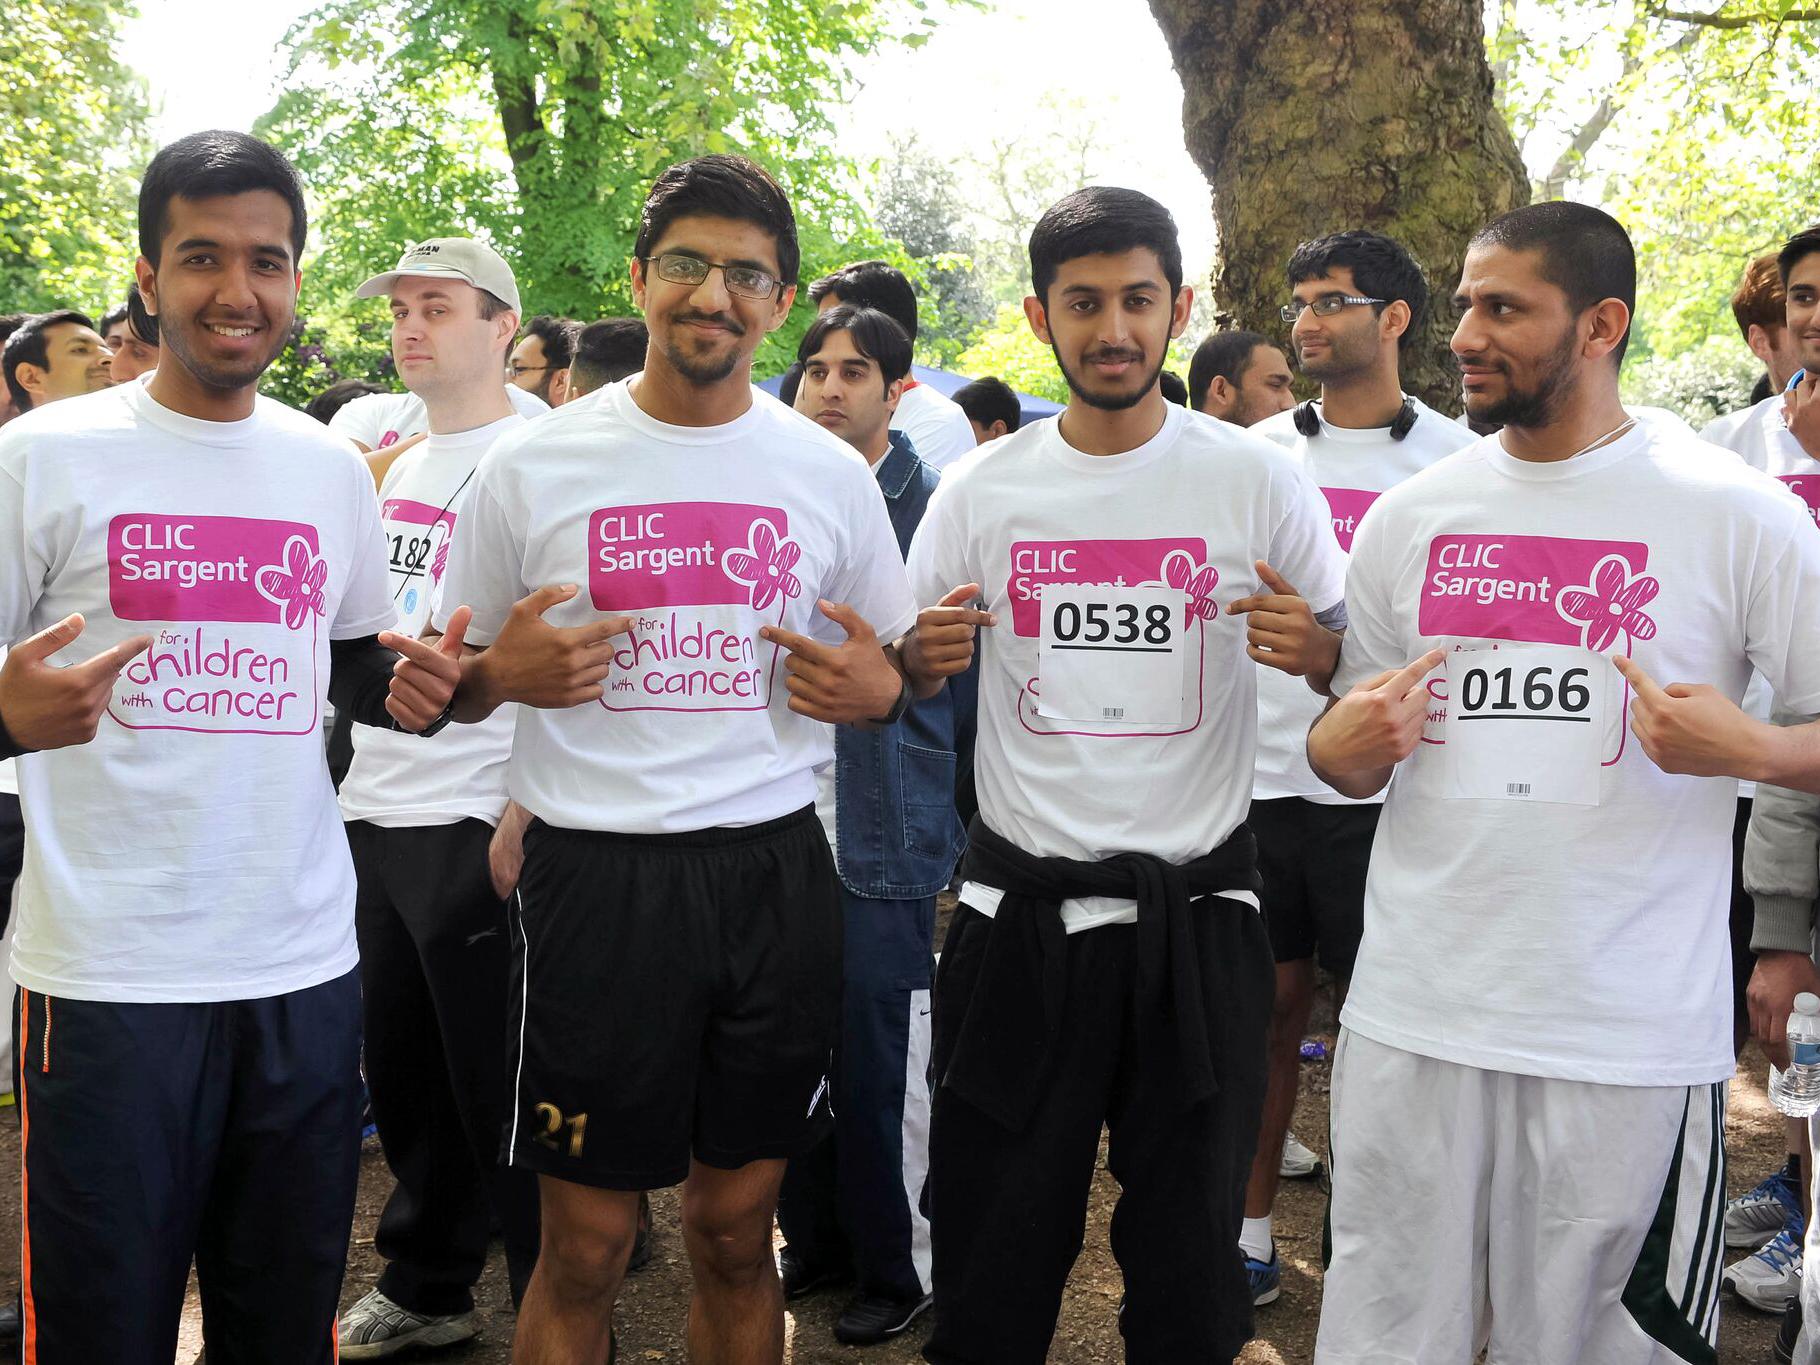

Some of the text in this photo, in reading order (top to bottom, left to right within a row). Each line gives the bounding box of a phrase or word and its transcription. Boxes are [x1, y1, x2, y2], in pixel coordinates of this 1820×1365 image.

[120, 523, 195, 550] CLIC
[600, 512, 665, 543] CLIC
[386, 532, 431, 570] 182
[599, 540, 715, 575] Sargent
[1015, 549, 1077, 574] CLIC
[1438, 543, 1504, 569] CLIC
[120, 553, 249, 588] Sargent
[1430, 571, 1551, 604] Sargent
[160, 629, 182, 645] for
[638, 616, 658, 631] for
[1053, 602, 1172, 644] 0538
[126, 627, 288, 685] children
[613, 612, 754, 671] children
[611, 669, 761, 698] with cancer
[1461, 666, 1590, 713] 0166
[121, 687, 298, 721] with cancer
[533, 1101, 588, 1158] 21
